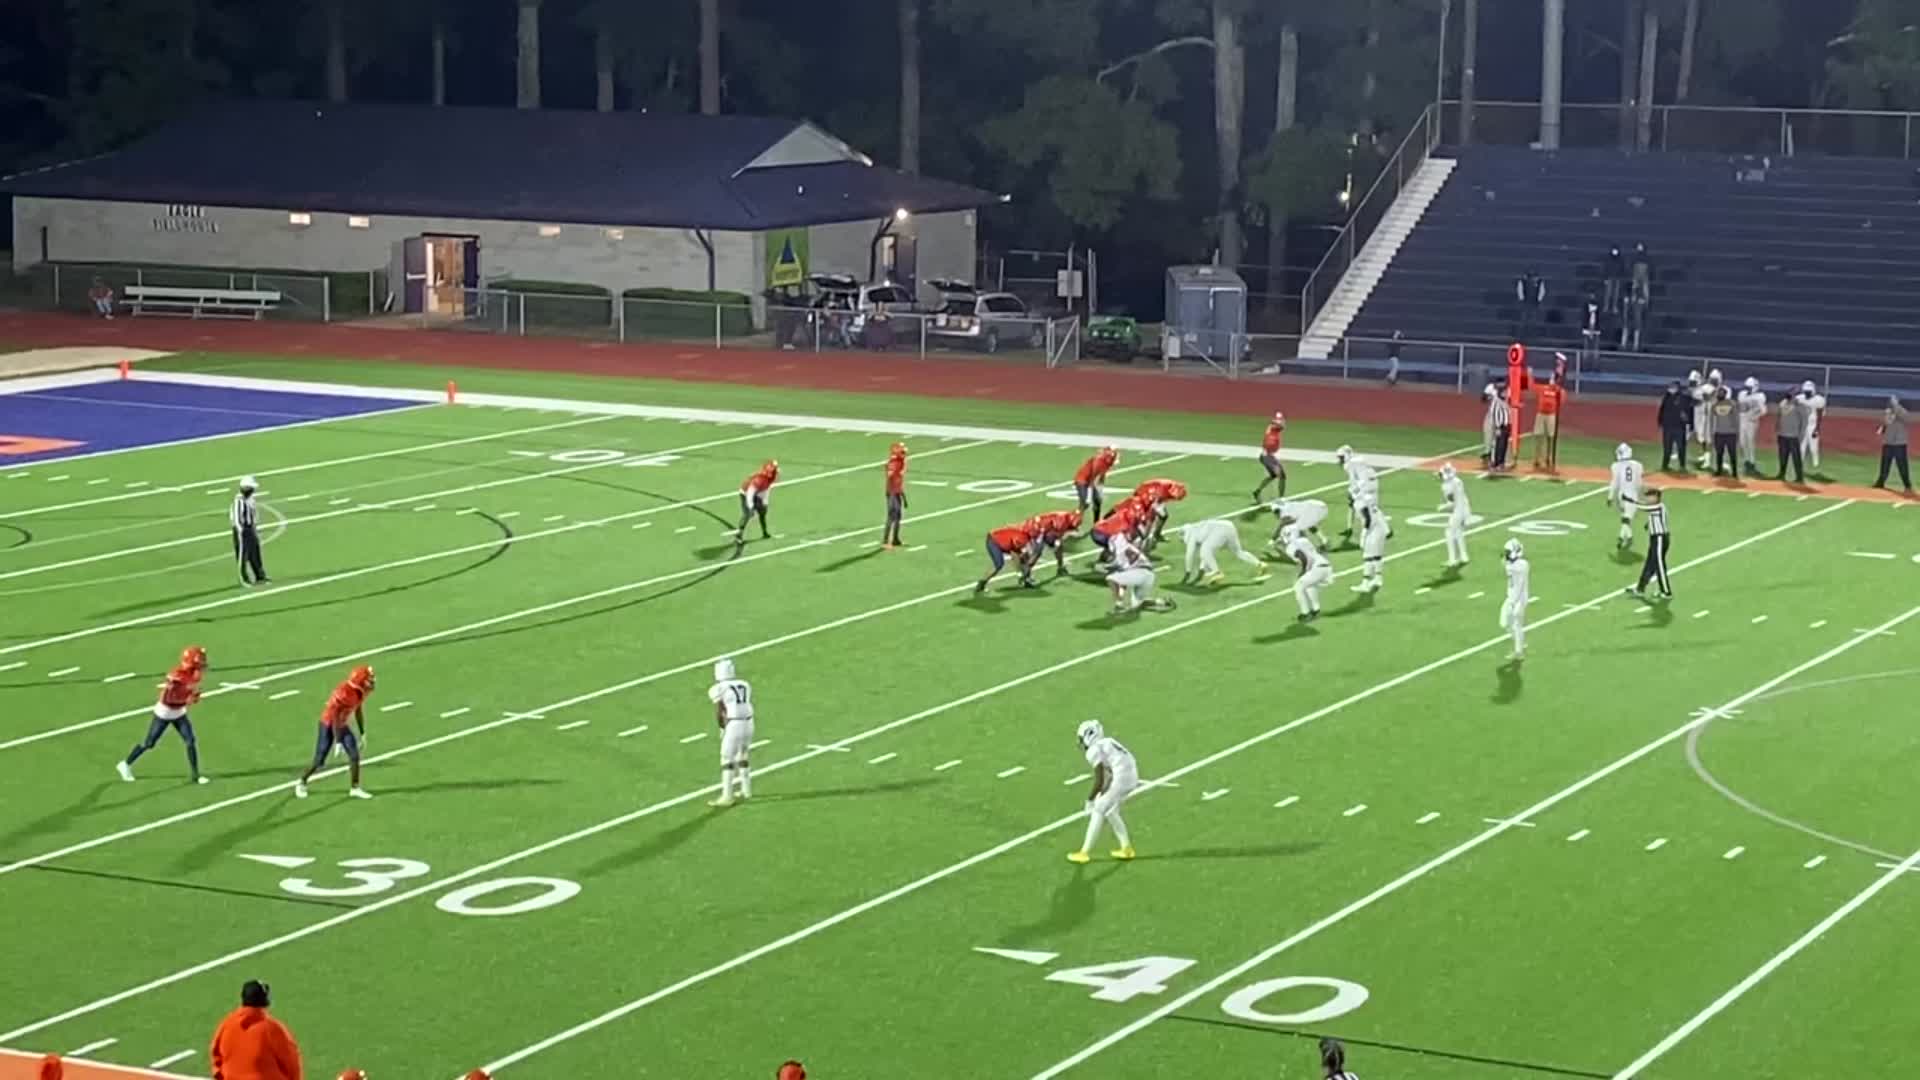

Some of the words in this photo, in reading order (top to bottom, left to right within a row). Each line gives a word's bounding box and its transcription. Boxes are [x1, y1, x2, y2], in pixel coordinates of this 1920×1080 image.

[730, 684, 747, 704] 17
[279, 857, 582, 916] 30
[1043, 955, 1370, 1023] 40
